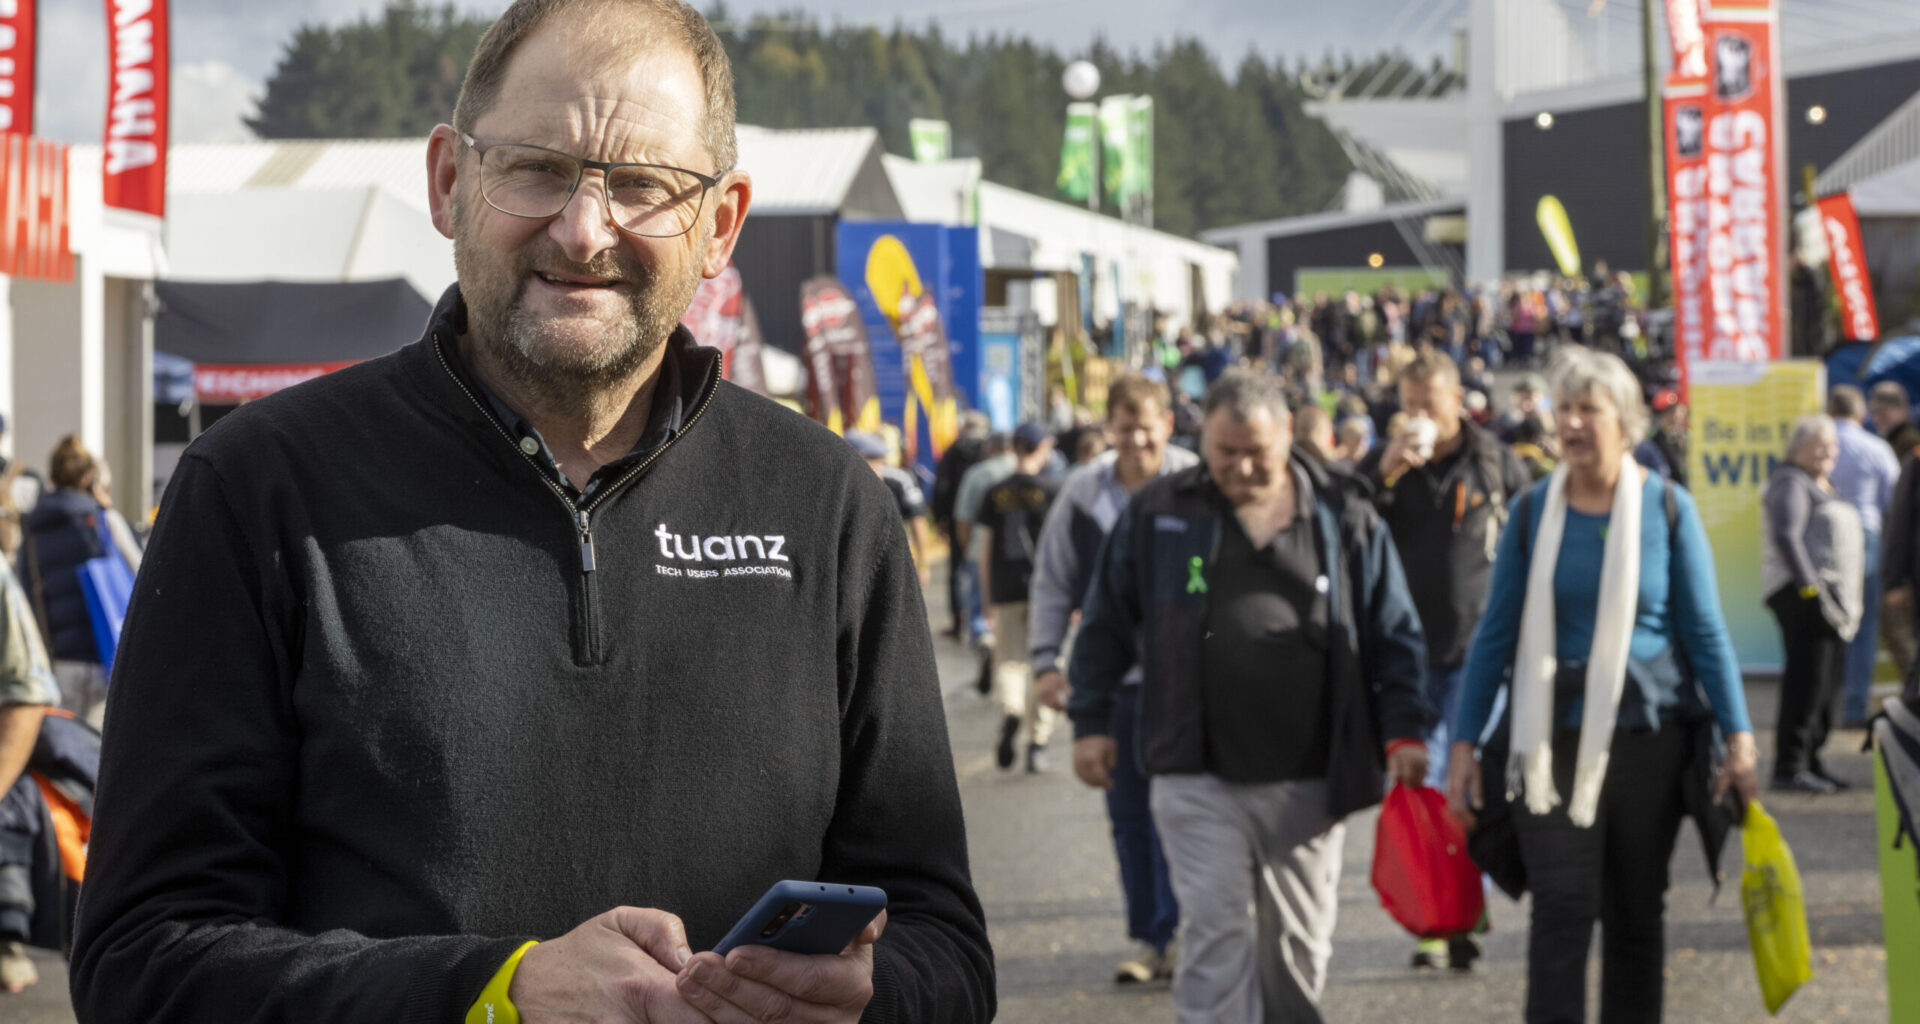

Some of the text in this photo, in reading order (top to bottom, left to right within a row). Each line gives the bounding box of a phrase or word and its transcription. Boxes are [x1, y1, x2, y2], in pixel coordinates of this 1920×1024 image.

[654, 523, 789, 562] tuanz
[655, 564, 792, 578] TECH USERS ASSOCIATION
